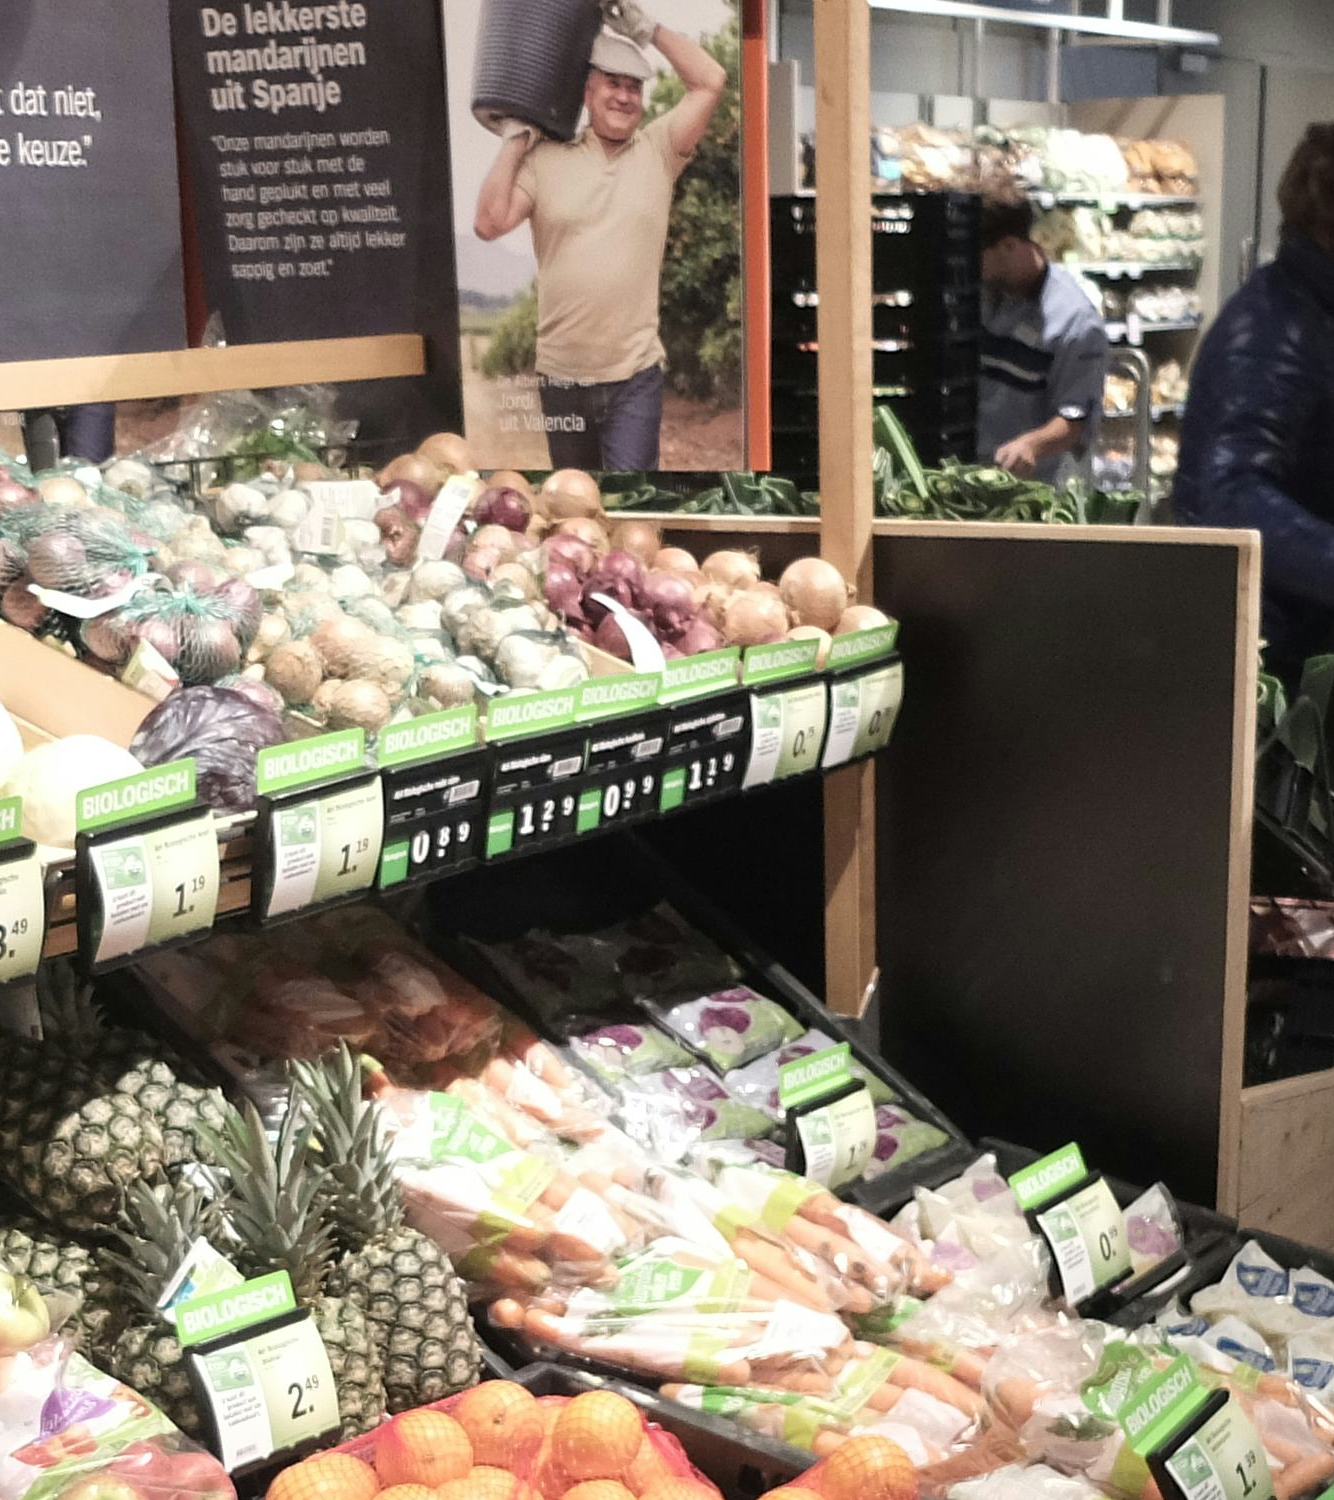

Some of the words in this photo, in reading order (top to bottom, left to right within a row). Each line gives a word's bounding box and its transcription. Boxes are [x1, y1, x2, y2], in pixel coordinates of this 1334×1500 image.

[202, 8, 237, 37] De
[244, 2, 367, 34] lekkerste
[206, 37, 367, 75] mandarijnen
[10, 83, 46, 117] dat
[53, 85, 102, 120] niet,
[210, 80, 245, 111] uit
[253, 74, 342, 115] Spanje
[253, 131, 337, 152] mandarijnen
[339, 127, 391, 147] worden
[219, 160, 250, 178] stuk
[251, 162, 280, 176] voor
[284, 157, 313, 175] stuk
[317, 157, 344, 173] met
[348, 155, 365, 173] de
[312, 184, 330, 199] en
[334, 182, 361, 198] met
[364, 180, 391, 197] veel
[524, 412, 587, 433] Valencia
[385, 716, 471, 754] BIOLOGISCH
[264, 739, 359, 781] BIOLOGISCH
[82, 769, 189, 821] BIOLOGISCH
[183, 1281, 288, 1335] BIOLOGISCH
